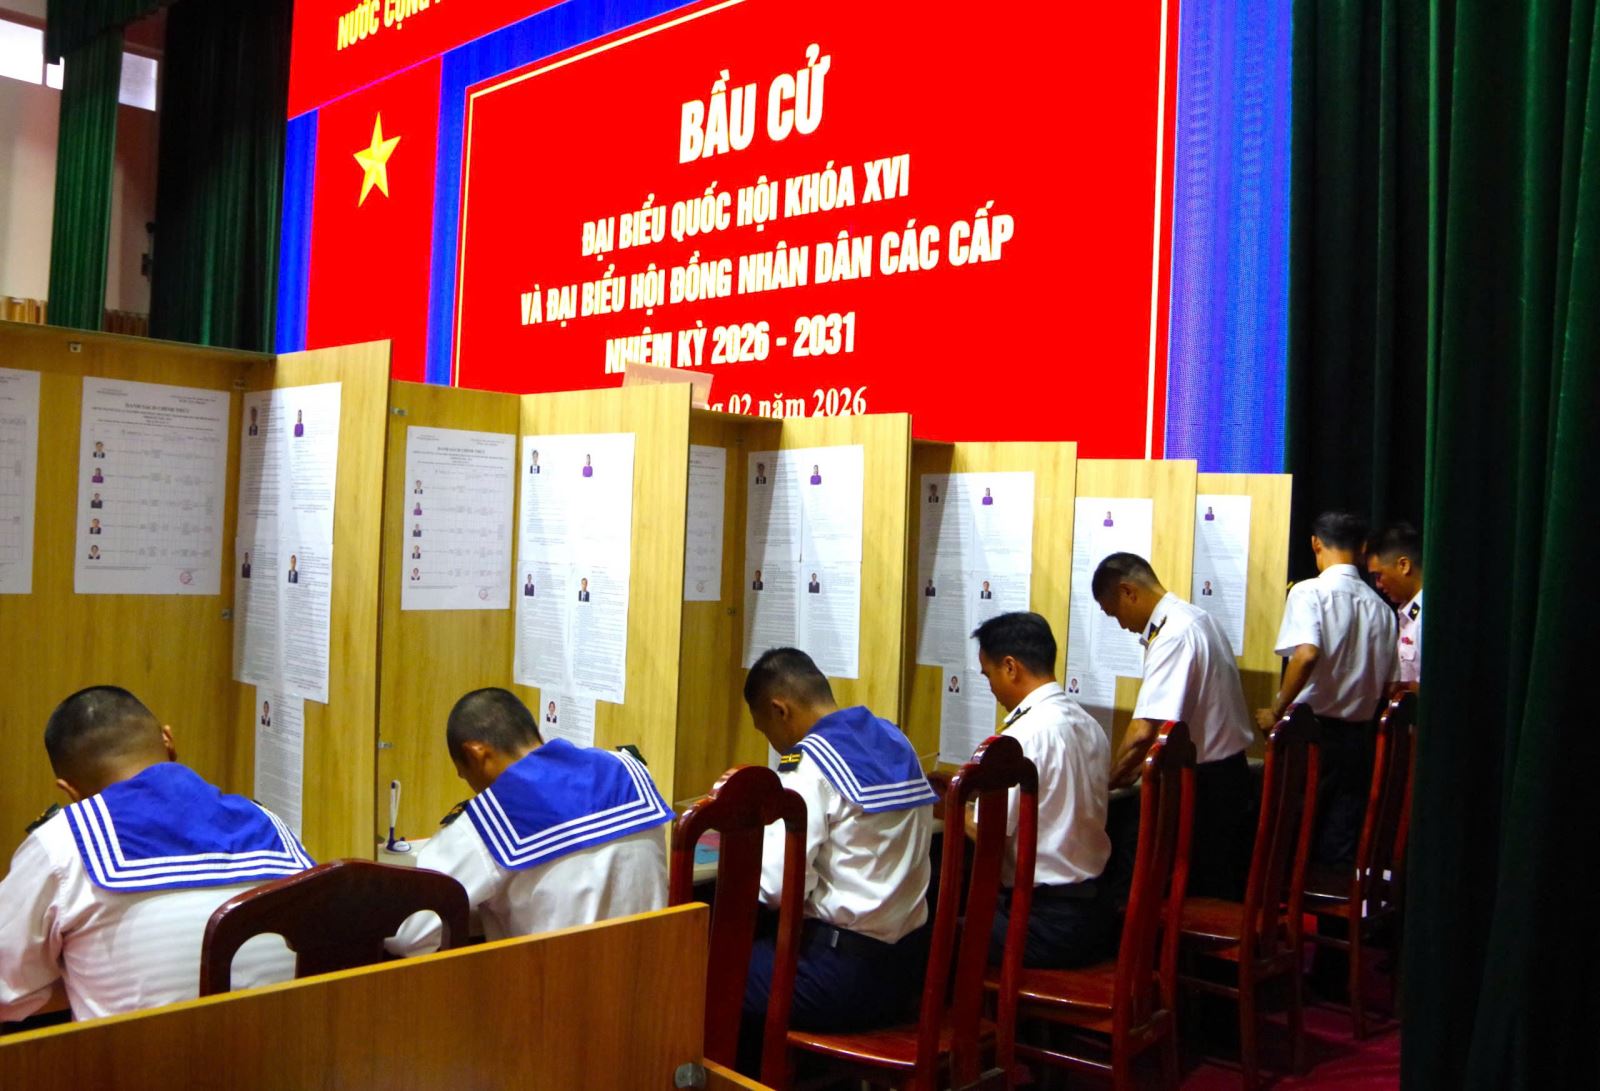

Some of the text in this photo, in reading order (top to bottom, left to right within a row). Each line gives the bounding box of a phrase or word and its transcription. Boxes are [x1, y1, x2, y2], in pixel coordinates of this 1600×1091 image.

[679, 43, 831, 164] BẦU CỬ
[581, 154, 910, 261] ĐẠI BIỂU QUỐC HỘI KHÓA XVI
[520, 200, 1015, 327] VÀ ĐẠI BIỂU HỘI ĐỒNG NHÂN DÂN CÁC CẤP
[677, 320, 708, 368] KỲ
[711, 321, 770, 365] 2026
[776, 336, 788, 347] -
[793, 312, 856, 358] 2031
[729, 394, 752, 416] 02
[759, 392, 806, 419] năm
[812, 386, 868, 417] 2026
